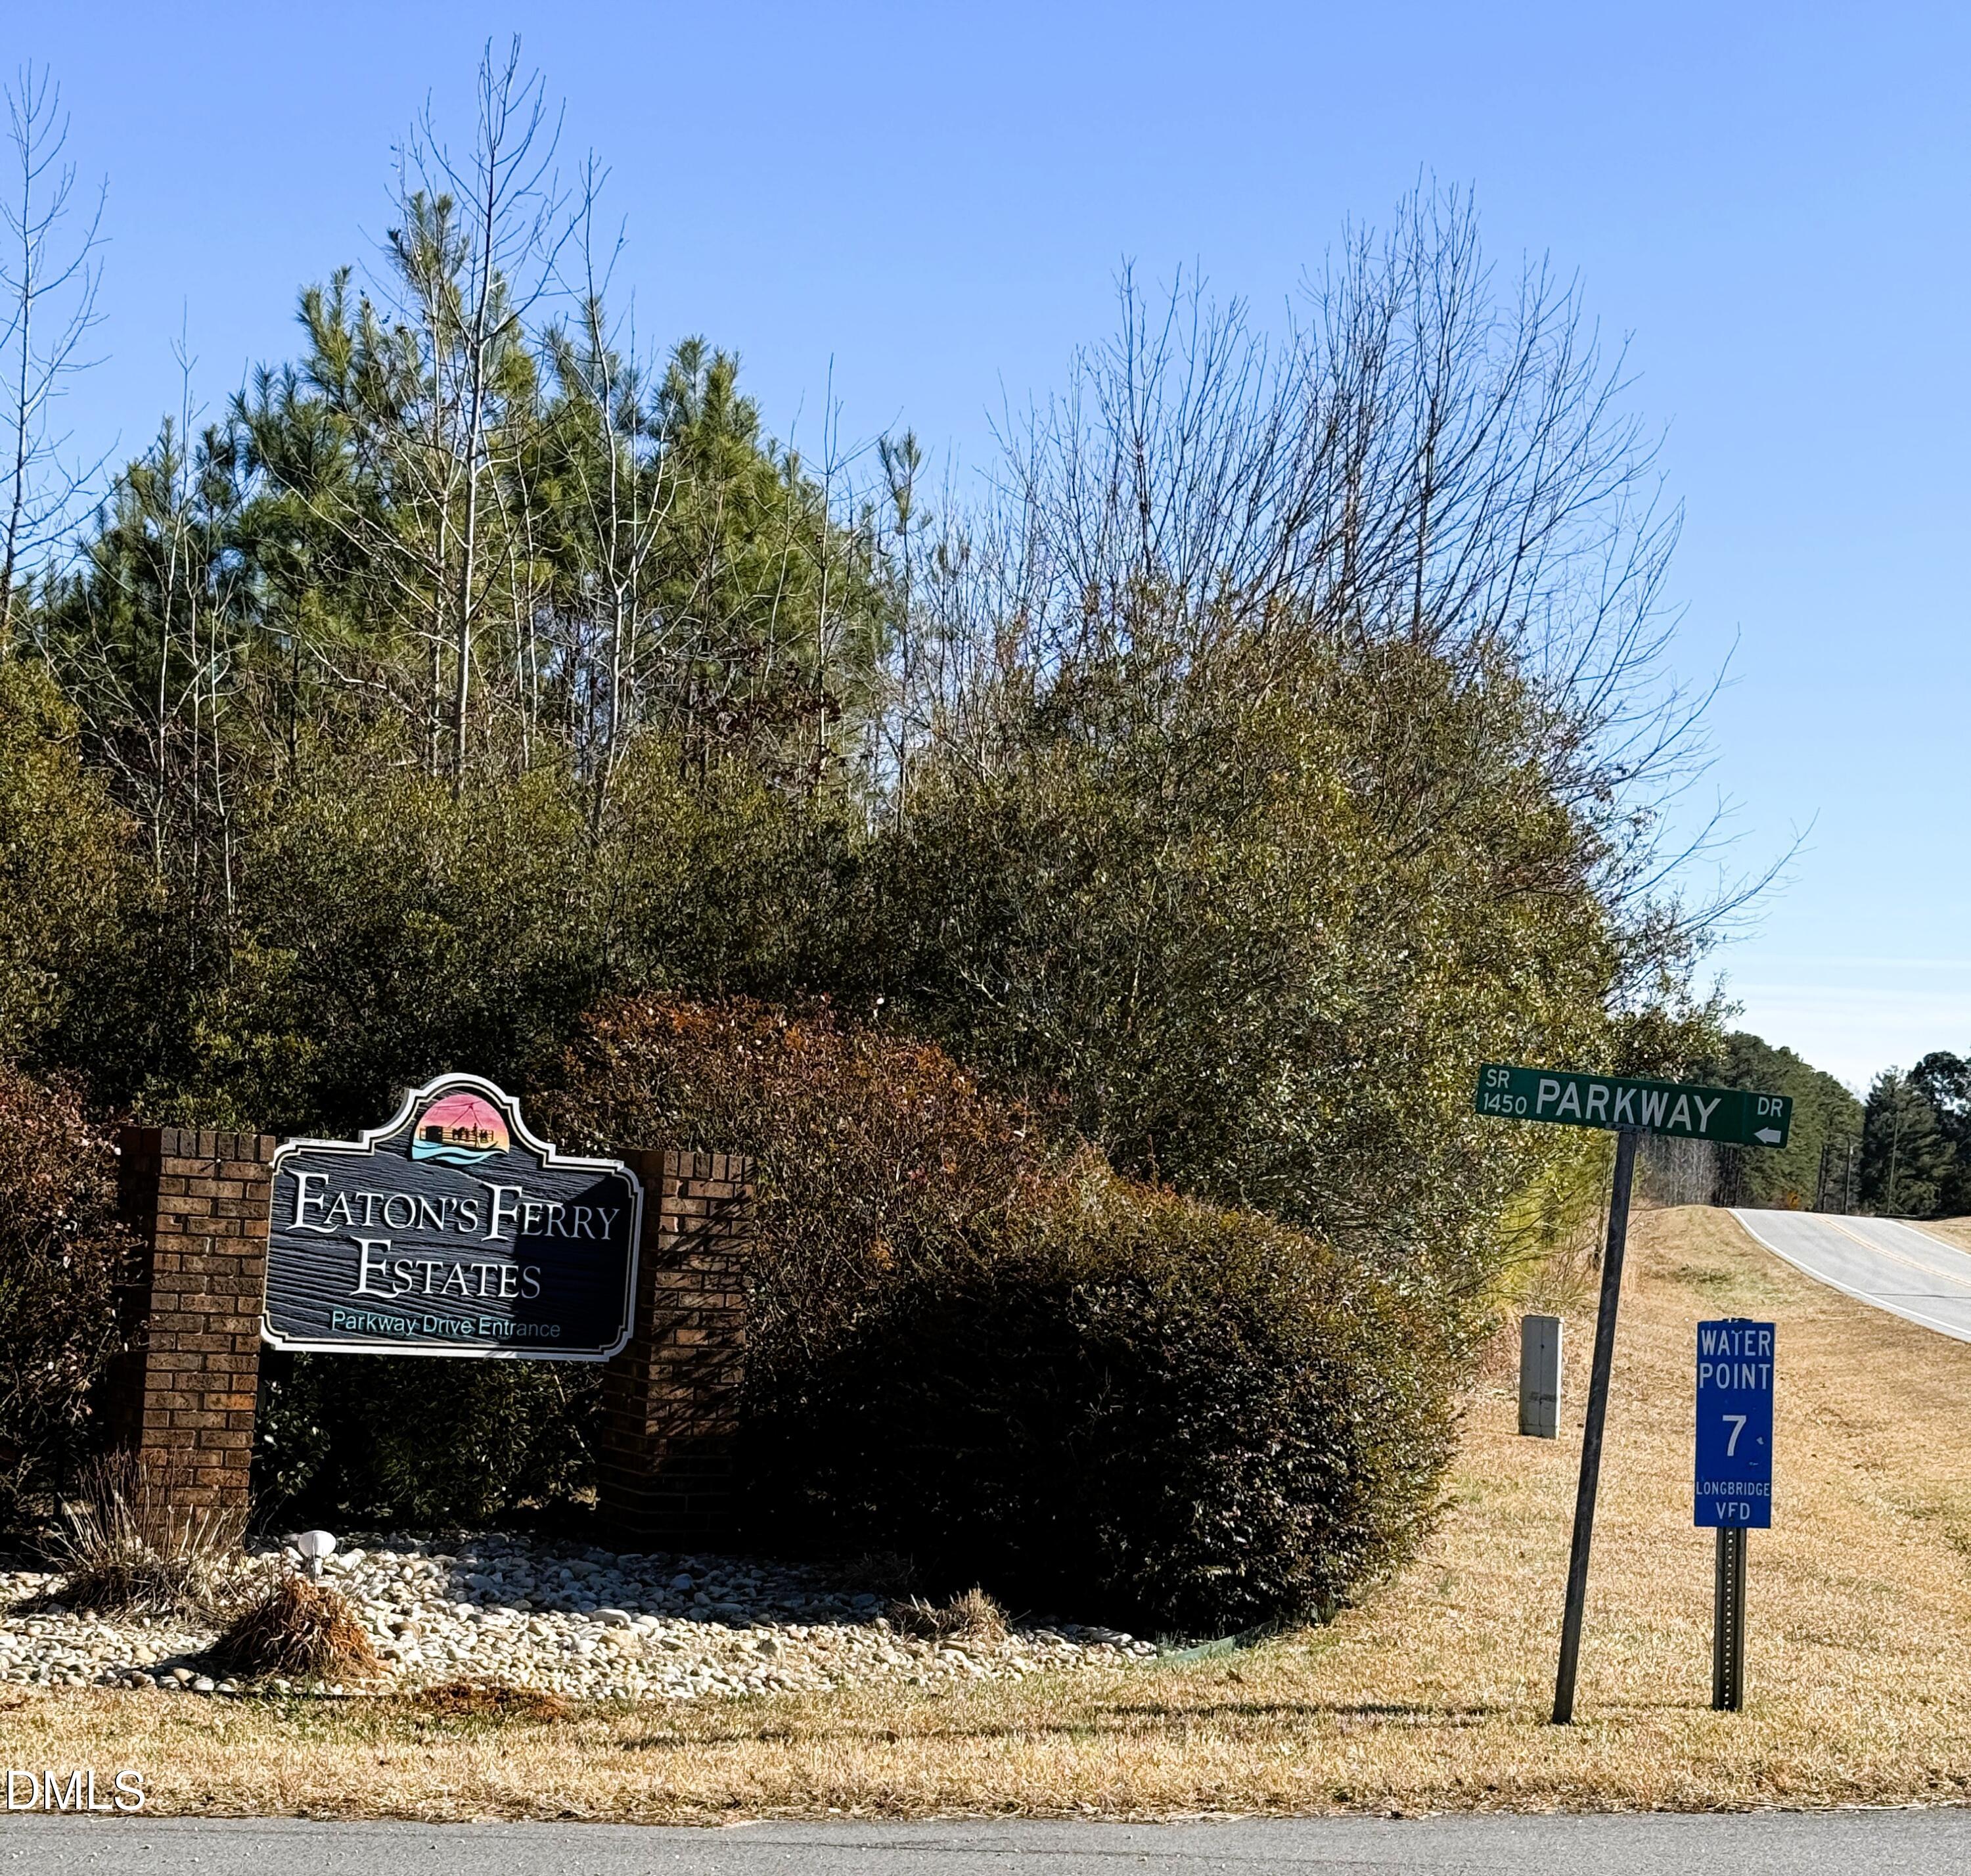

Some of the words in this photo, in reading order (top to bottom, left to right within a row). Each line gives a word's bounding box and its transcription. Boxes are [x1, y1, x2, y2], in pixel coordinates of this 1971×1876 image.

[1485, 1068, 1510, 1089] SR
[1483, 1092, 1527, 1115] 1450
[1536, 1078, 1721, 1133] PARKWAY
[1757, 1096, 1783, 1117] DR
[332, 1311, 418, 1337] Parkway
[422, 1314, 474, 1336] Drive
[478, 1316, 561, 1338] Entrance
[1701, 1329, 1771, 1357] WATER
[1699, 1363, 1771, 1390] POINT
[1722, 1415, 1747, 1457] 7
[1696, 1481, 1770, 1497] LONGBRIDGE
[1715, 1502, 1750, 1521] VFD
